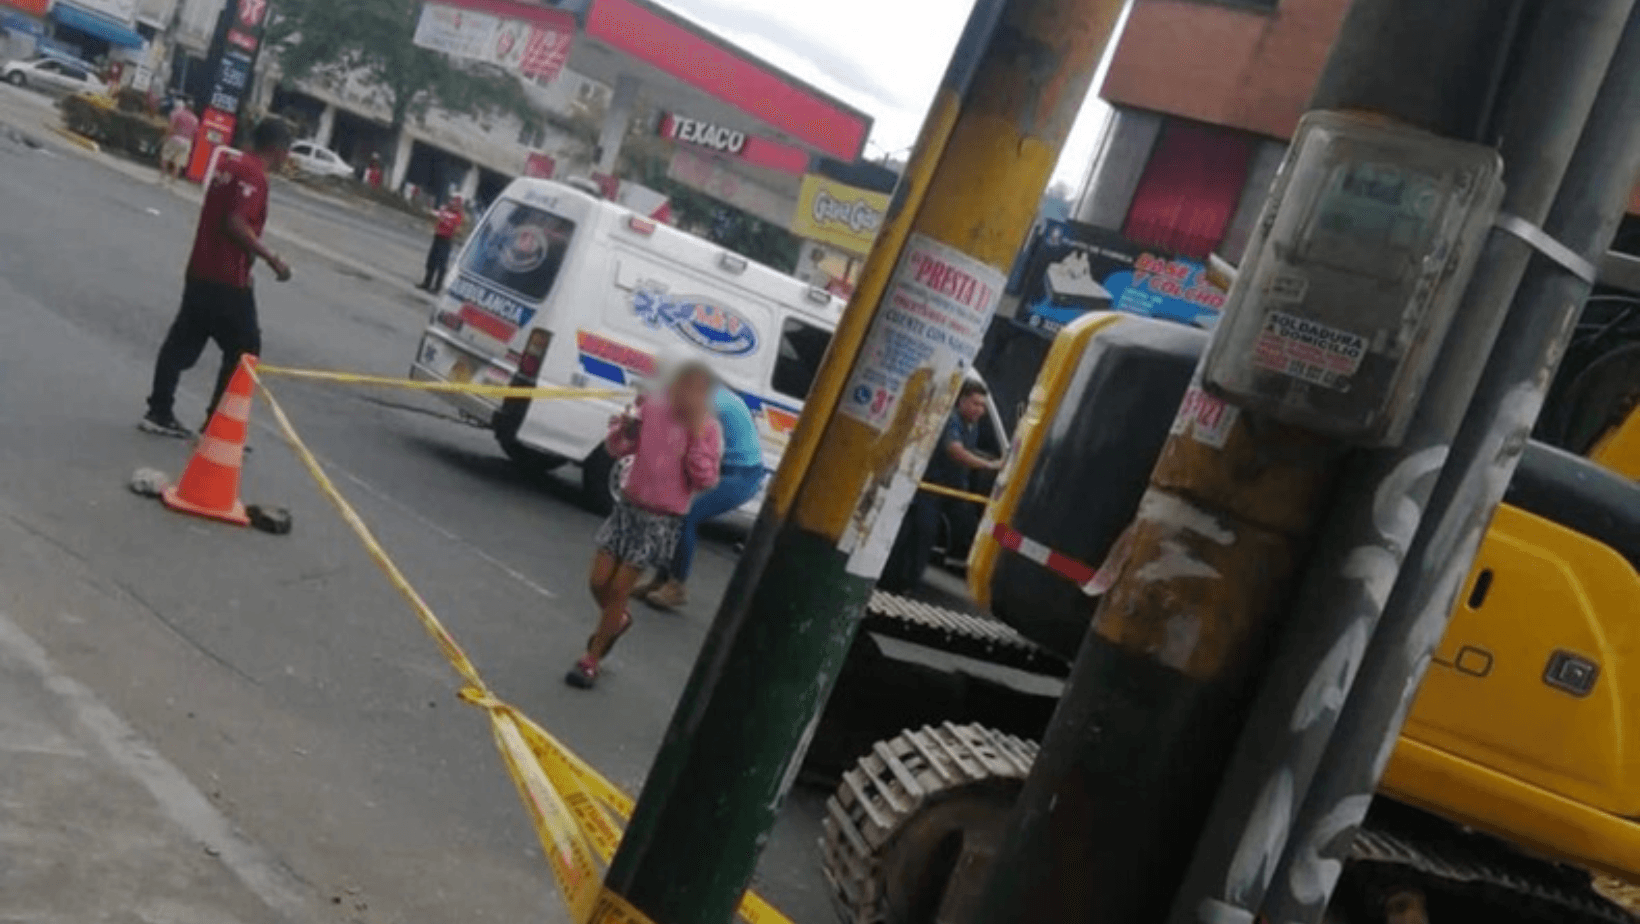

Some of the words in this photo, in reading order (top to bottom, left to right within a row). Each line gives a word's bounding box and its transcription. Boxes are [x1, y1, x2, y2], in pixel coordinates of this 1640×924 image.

[671, 115, 744, 152] TEXACO
[1271, 314, 1361, 350] SOLDADURA
[1280, 327, 1359, 358] DOMICILIO
